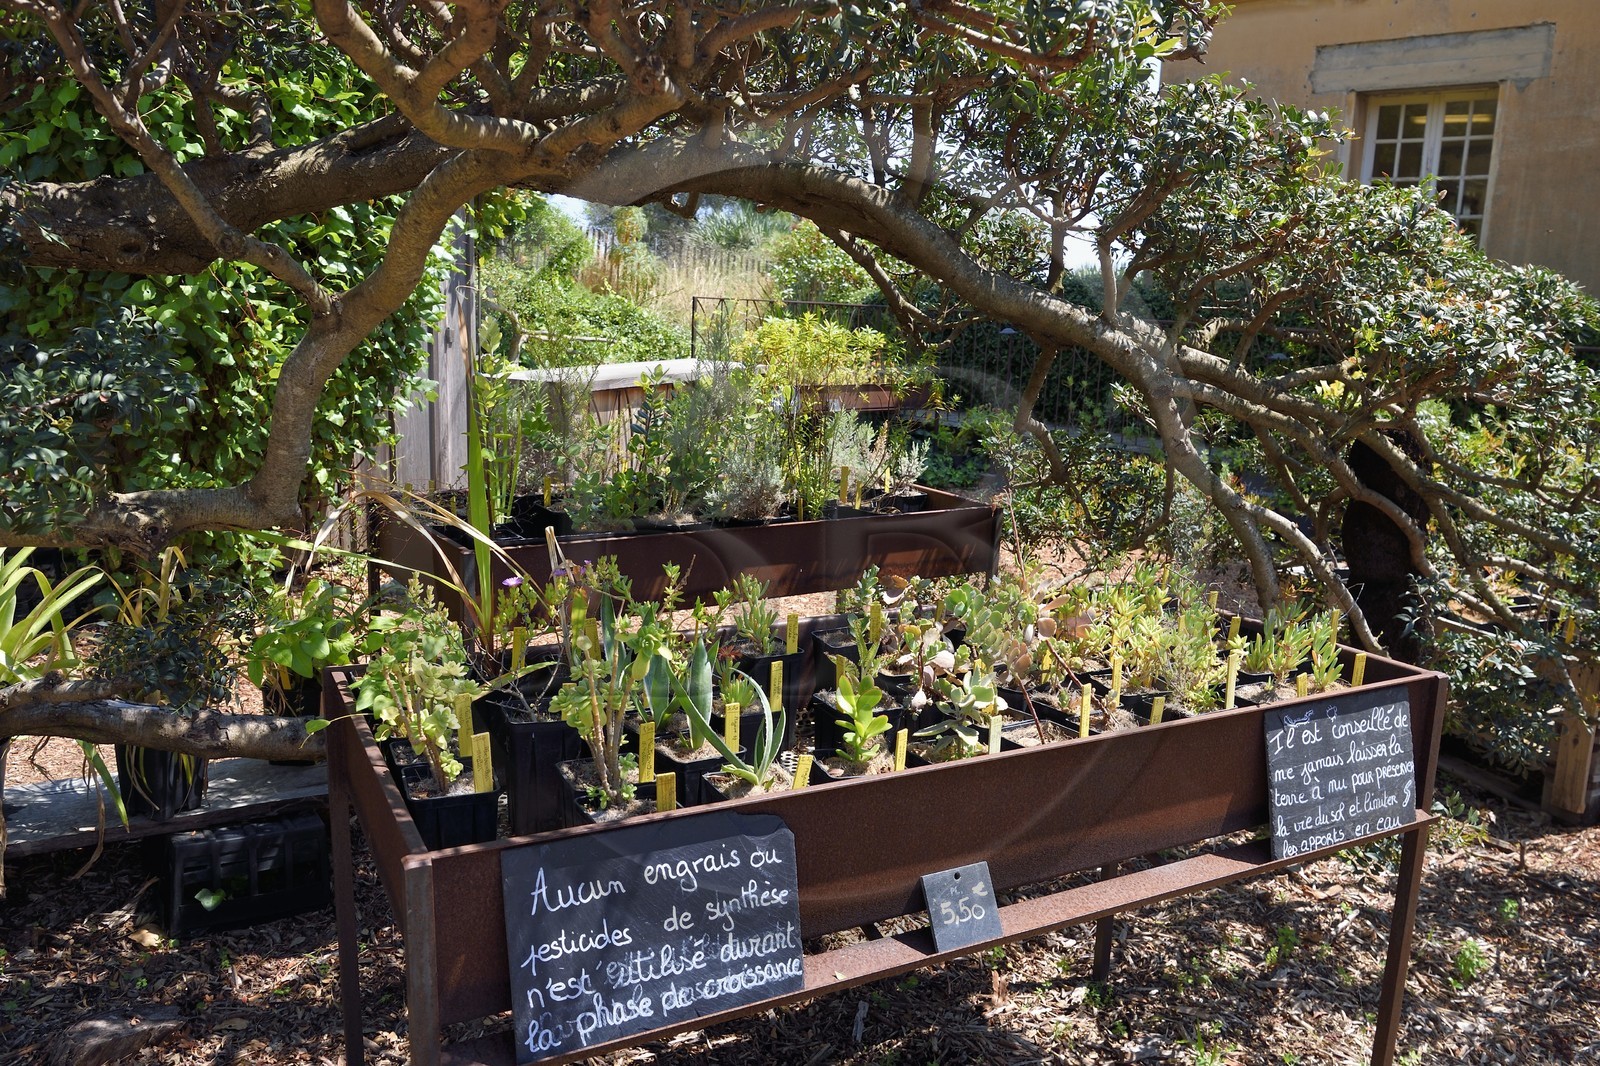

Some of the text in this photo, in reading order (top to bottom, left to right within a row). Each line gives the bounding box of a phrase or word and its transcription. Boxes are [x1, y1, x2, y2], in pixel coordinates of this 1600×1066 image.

[1270, 704, 1408, 755] Il est conseillé de
[1301, 749, 1344, 785] jamais
[1388, 734, 1404, 755] la
[1274, 788, 1309, 807] terre
[1312, 776, 1325, 800] à
[1276, 815, 1290, 837] la
[1294, 815, 1313, 832] vie
[1315, 805, 1329, 826] du
[1331, 802, 1345, 822] sol
[1349, 796, 1362, 816] et
[1355, 822, 1370, 837] en
[1376, 816, 1402, 831] eau
[531, 844, 782, 916] Aucun engrais ou
[520, 879, 789, 976] pesticides de synthèse
[720, 920, 796, 963] durant
